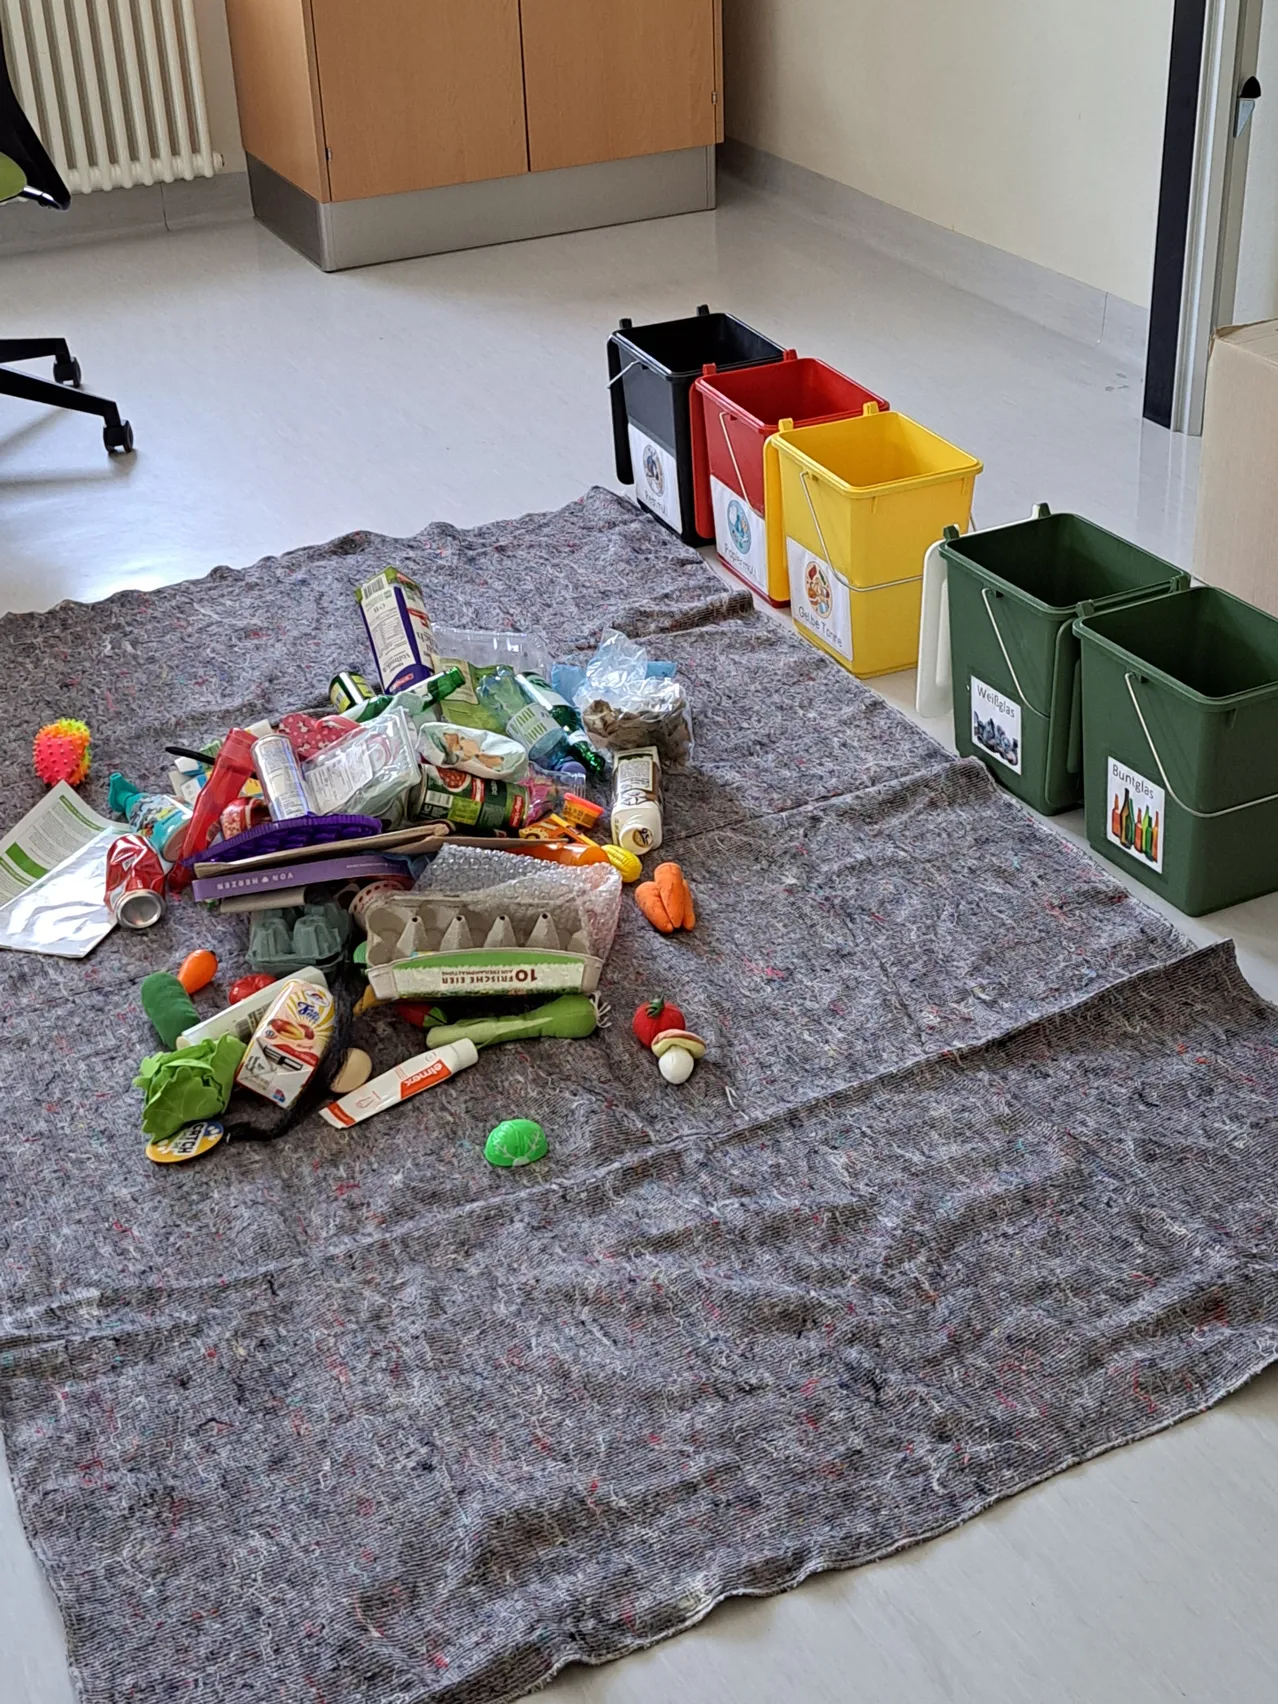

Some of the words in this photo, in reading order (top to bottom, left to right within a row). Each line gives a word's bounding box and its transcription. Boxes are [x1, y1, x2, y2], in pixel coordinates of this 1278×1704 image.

[798, 606, 820, 632] Gelbe
[820, 620, 844, 646] Tonne
[976, 684, 1016, 719] Weißglas
[1112, 763, 1155, 800] Buntglas
[216, 876, 259, 890] HERZEN
[272, 871, 294, 882] VON
[441, 976, 465, 985] EIER
[469, 974, 513, 984] FRISCHE
[514, 968, 537, 983] 10
[403, 1061, 443, 1087] elmex
